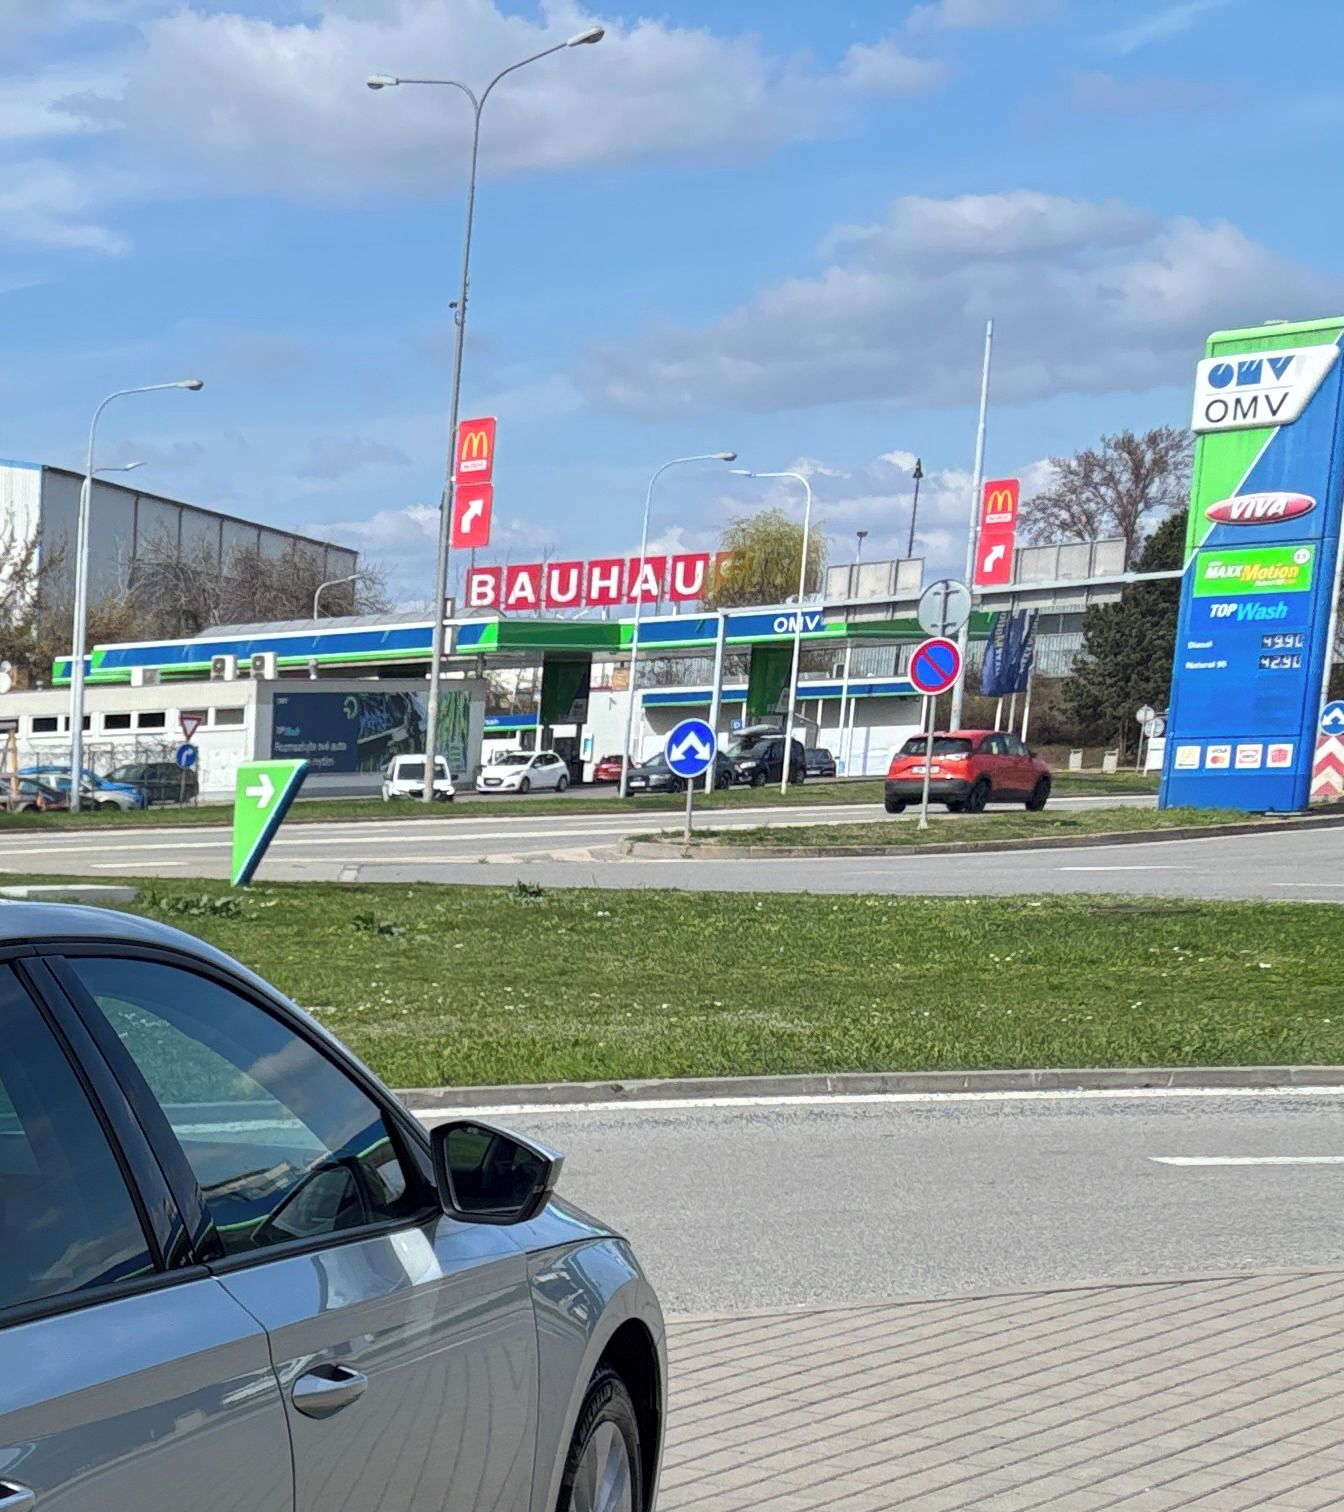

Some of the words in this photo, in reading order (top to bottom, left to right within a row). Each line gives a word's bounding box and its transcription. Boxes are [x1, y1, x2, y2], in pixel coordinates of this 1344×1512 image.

[1205, 391, 1289, 423] OMV
[1230, 499, 1288, 519] VIVA
[773, 614, 820, 633] OMV
